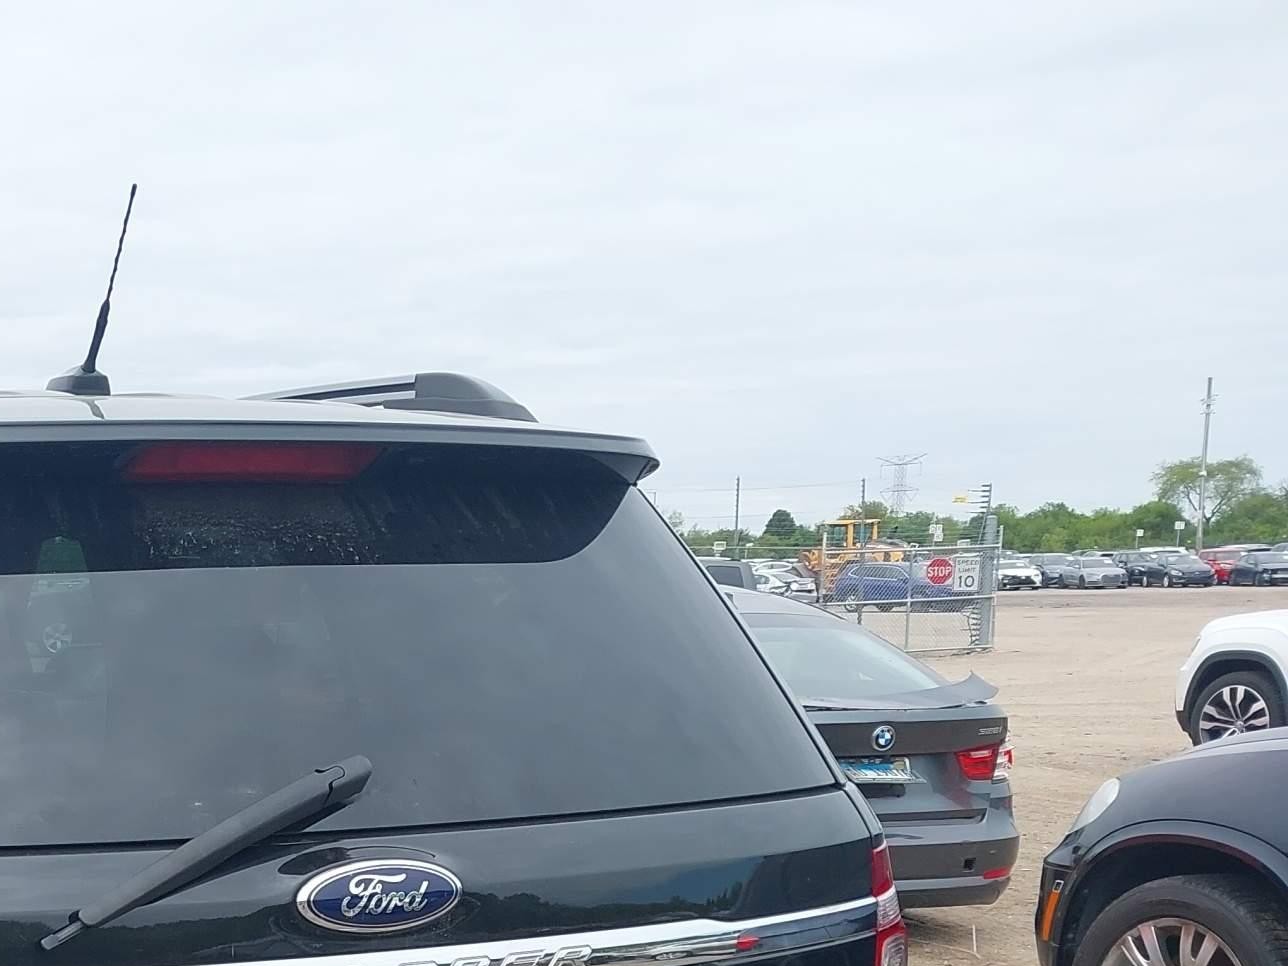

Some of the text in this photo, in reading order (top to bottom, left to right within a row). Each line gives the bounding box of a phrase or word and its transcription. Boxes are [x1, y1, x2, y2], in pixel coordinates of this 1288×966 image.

[927, 566, 952, 577] STOP
[958, 575, 975, 588] 10
[341, 872, 430, 918] Ford
